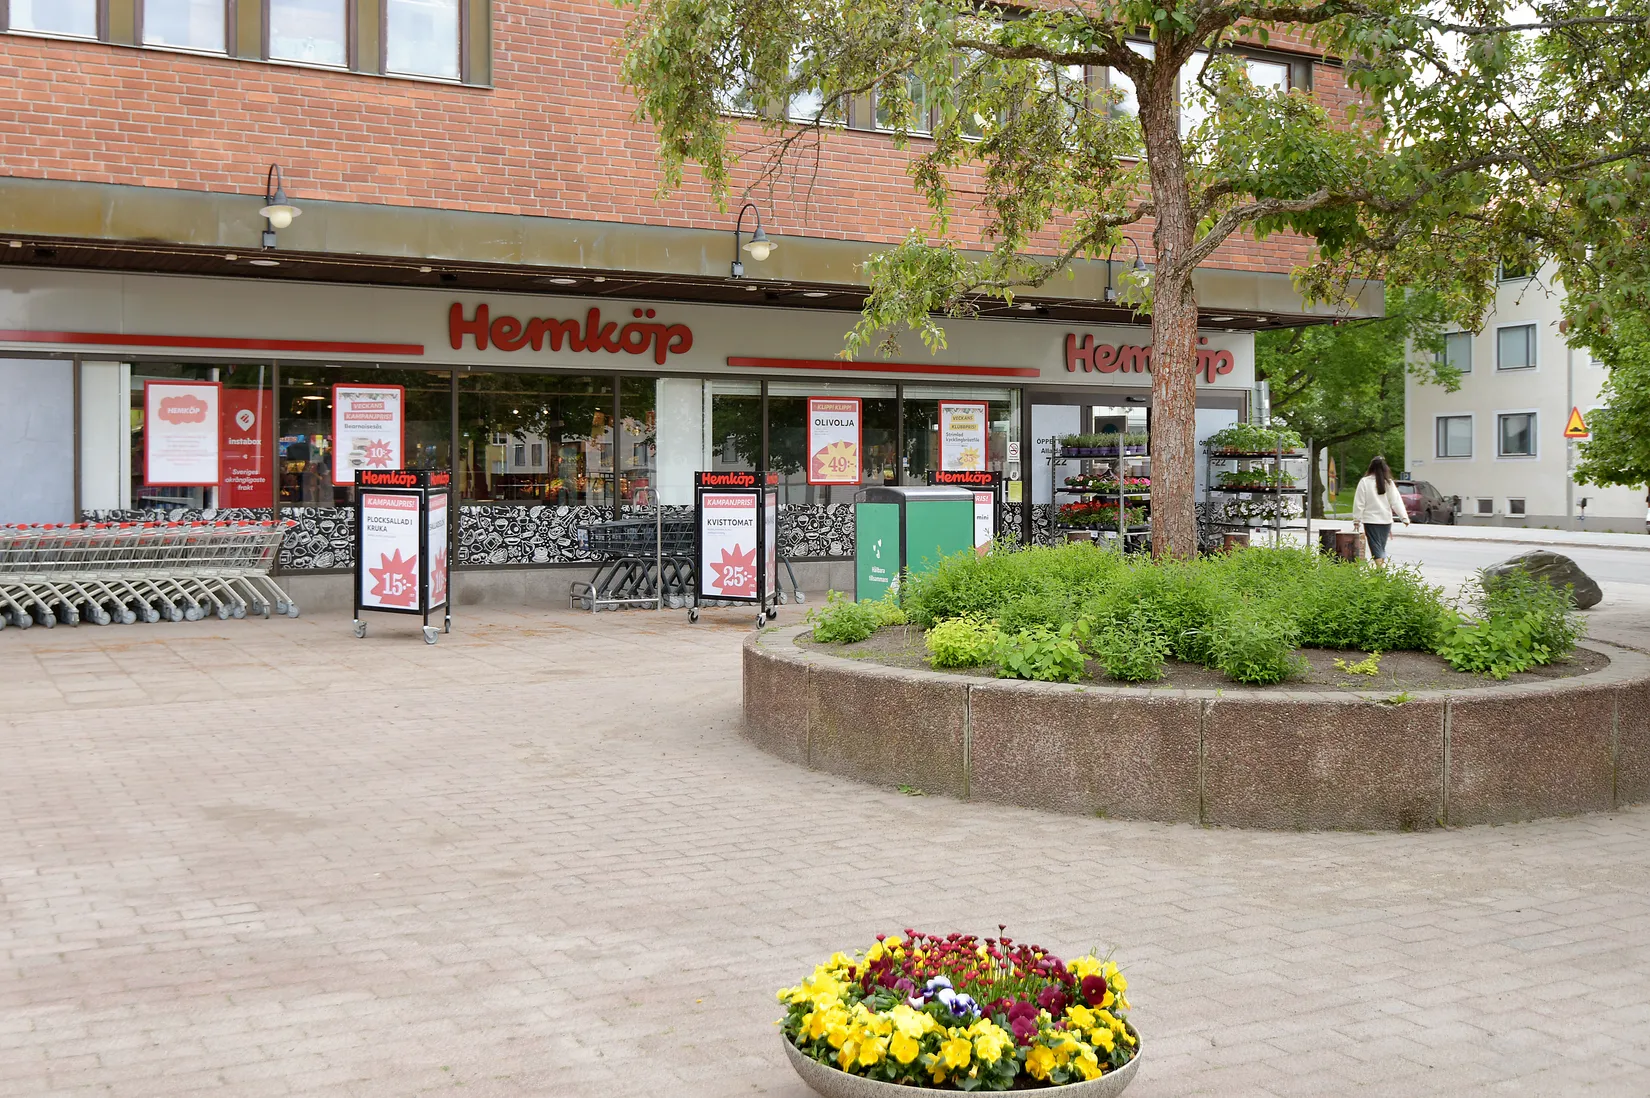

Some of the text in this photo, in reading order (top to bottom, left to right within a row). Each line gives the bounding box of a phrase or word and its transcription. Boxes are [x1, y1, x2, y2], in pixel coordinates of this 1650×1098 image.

[450, 302, 693, 365] Hemköp
[167, 406, 200, 414] HEMKÖP
[345, 412, 392, 420] KAMPANJPRIS!
[814, 418, 855, 427] OLIVOLJA
[228, 437, 262, 445] instabox
[362, 470, 417, 488] Hemköp
[702, 472, 755, 487] Hemköp
[935, 471, 992, 485] Hemköp
[367, 498, 415, 508] KAMPANJPRIS!
[367, 516, 410, 525] PLOCKSALLAD
[707, 518, 753, 526] KVISTTOMAT
[723, 565, 753, 587] 25:-
[382, 572, 412, 596] 15:-
